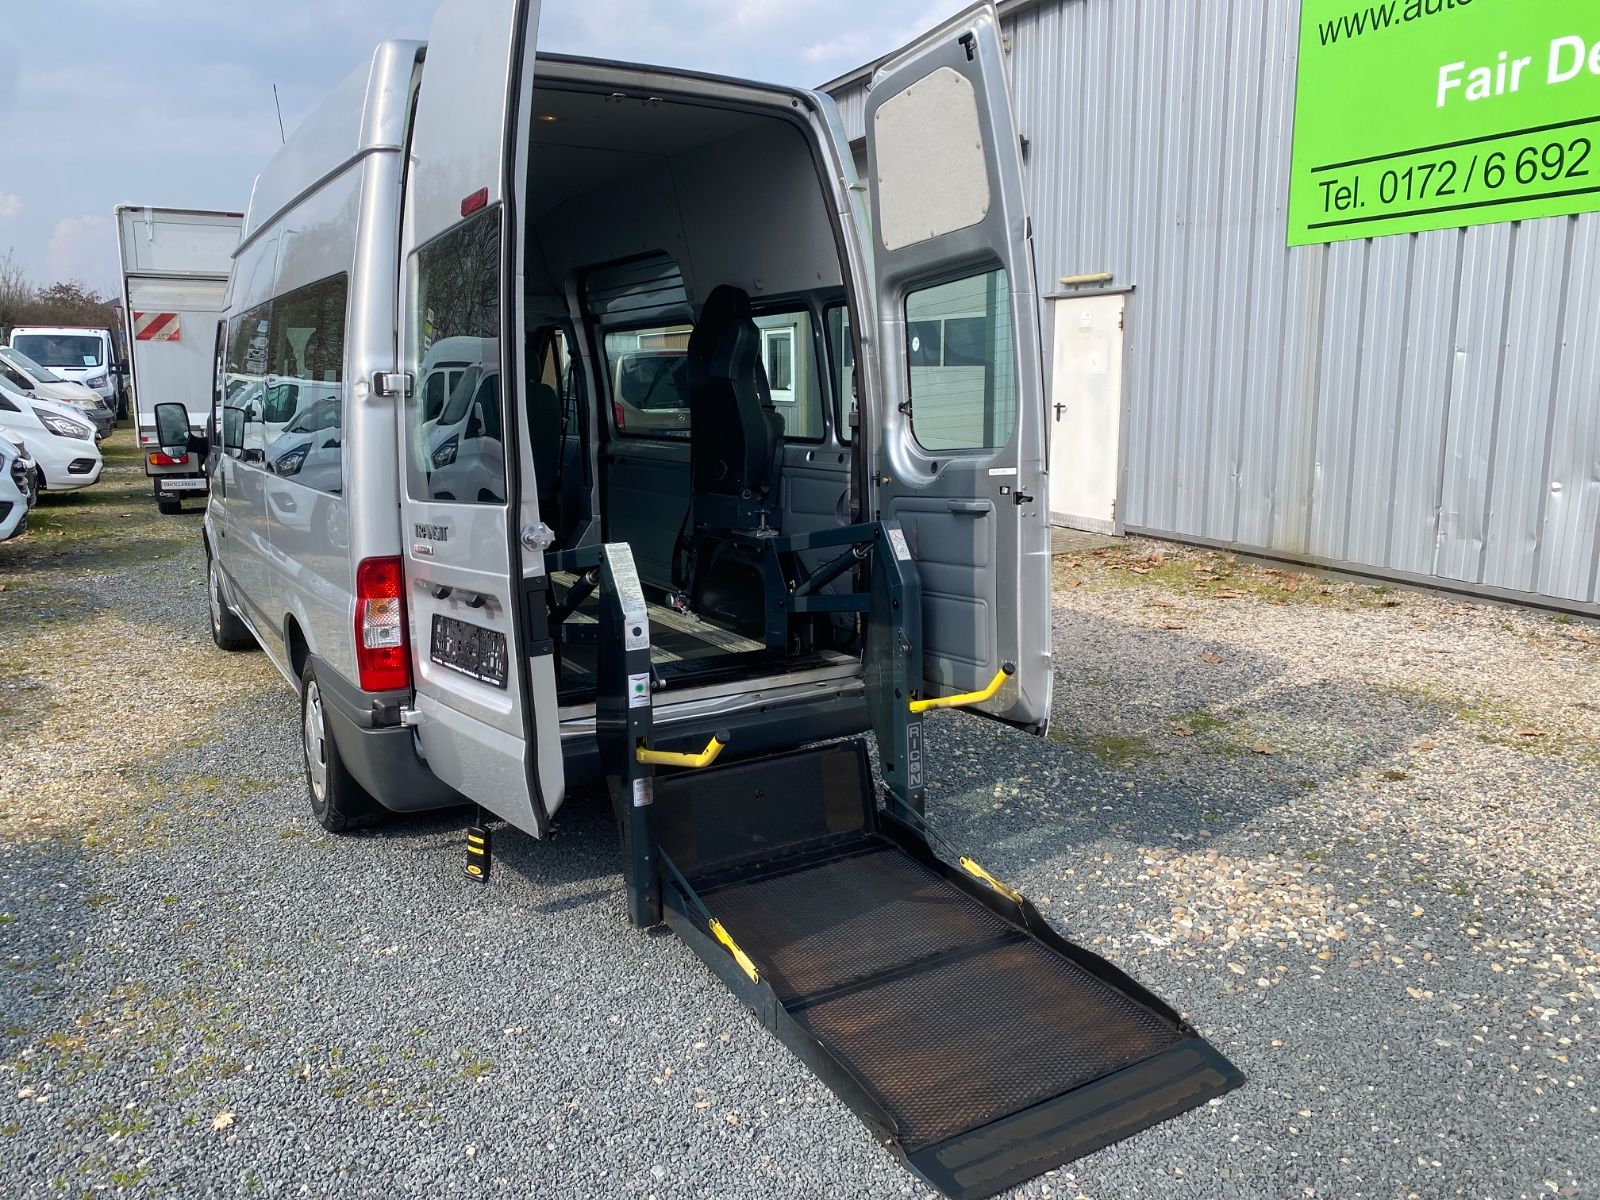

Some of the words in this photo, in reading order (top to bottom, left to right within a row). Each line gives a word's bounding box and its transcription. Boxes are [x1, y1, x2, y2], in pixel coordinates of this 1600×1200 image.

[1436, 50, 1532, 108] Fair
[1318, 176, 1365, 213] Tel.
[909, 726, 922, 786] RICON
